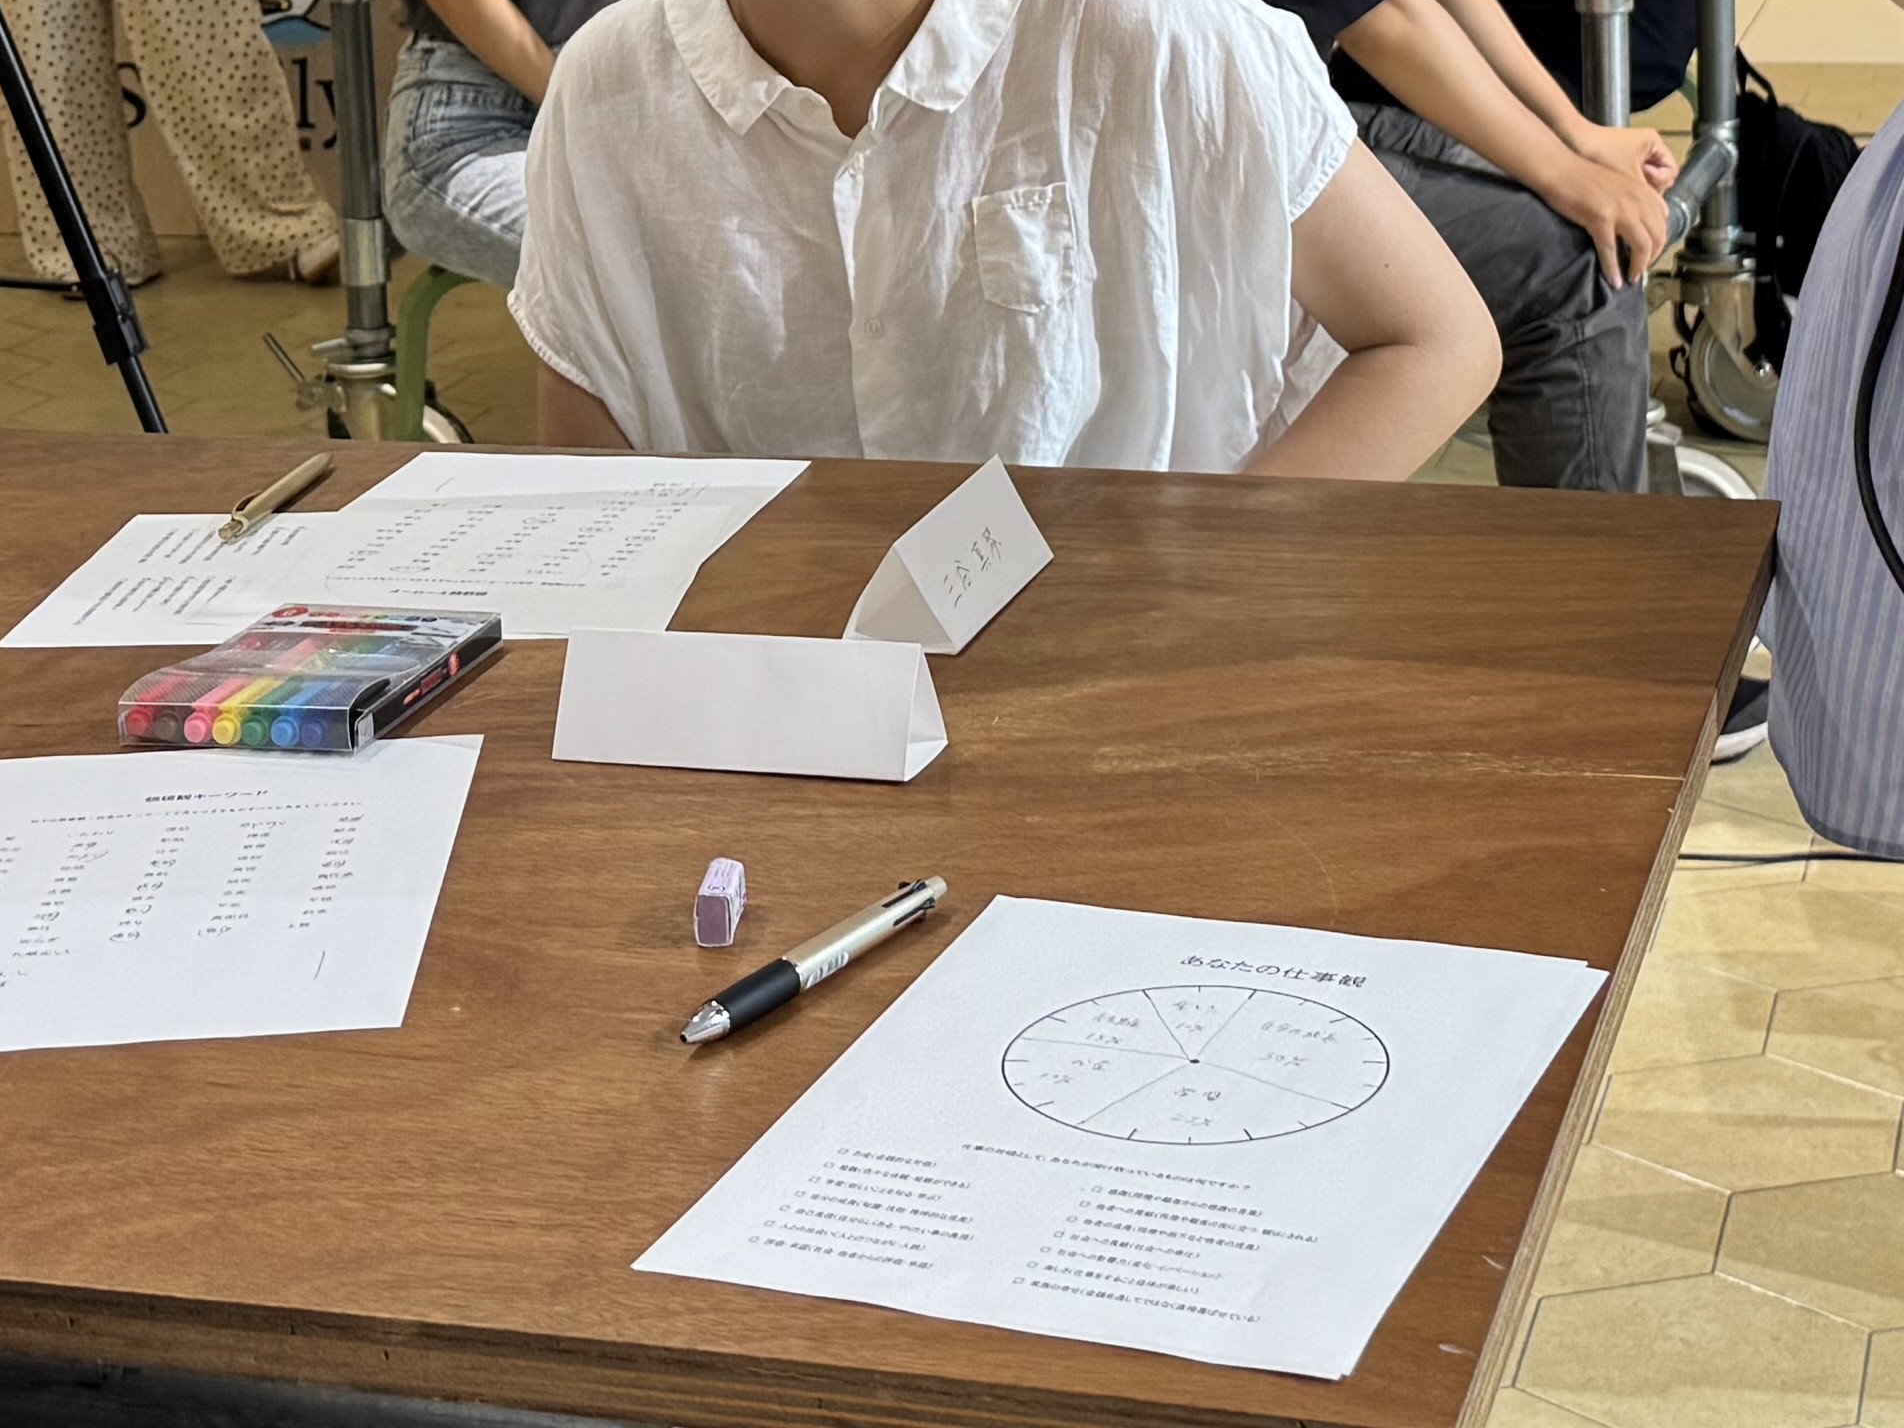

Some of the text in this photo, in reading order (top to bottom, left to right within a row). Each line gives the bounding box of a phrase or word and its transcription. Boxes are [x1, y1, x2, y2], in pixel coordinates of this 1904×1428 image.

[1180, 955, 1367, 988] あなたの仕事観
